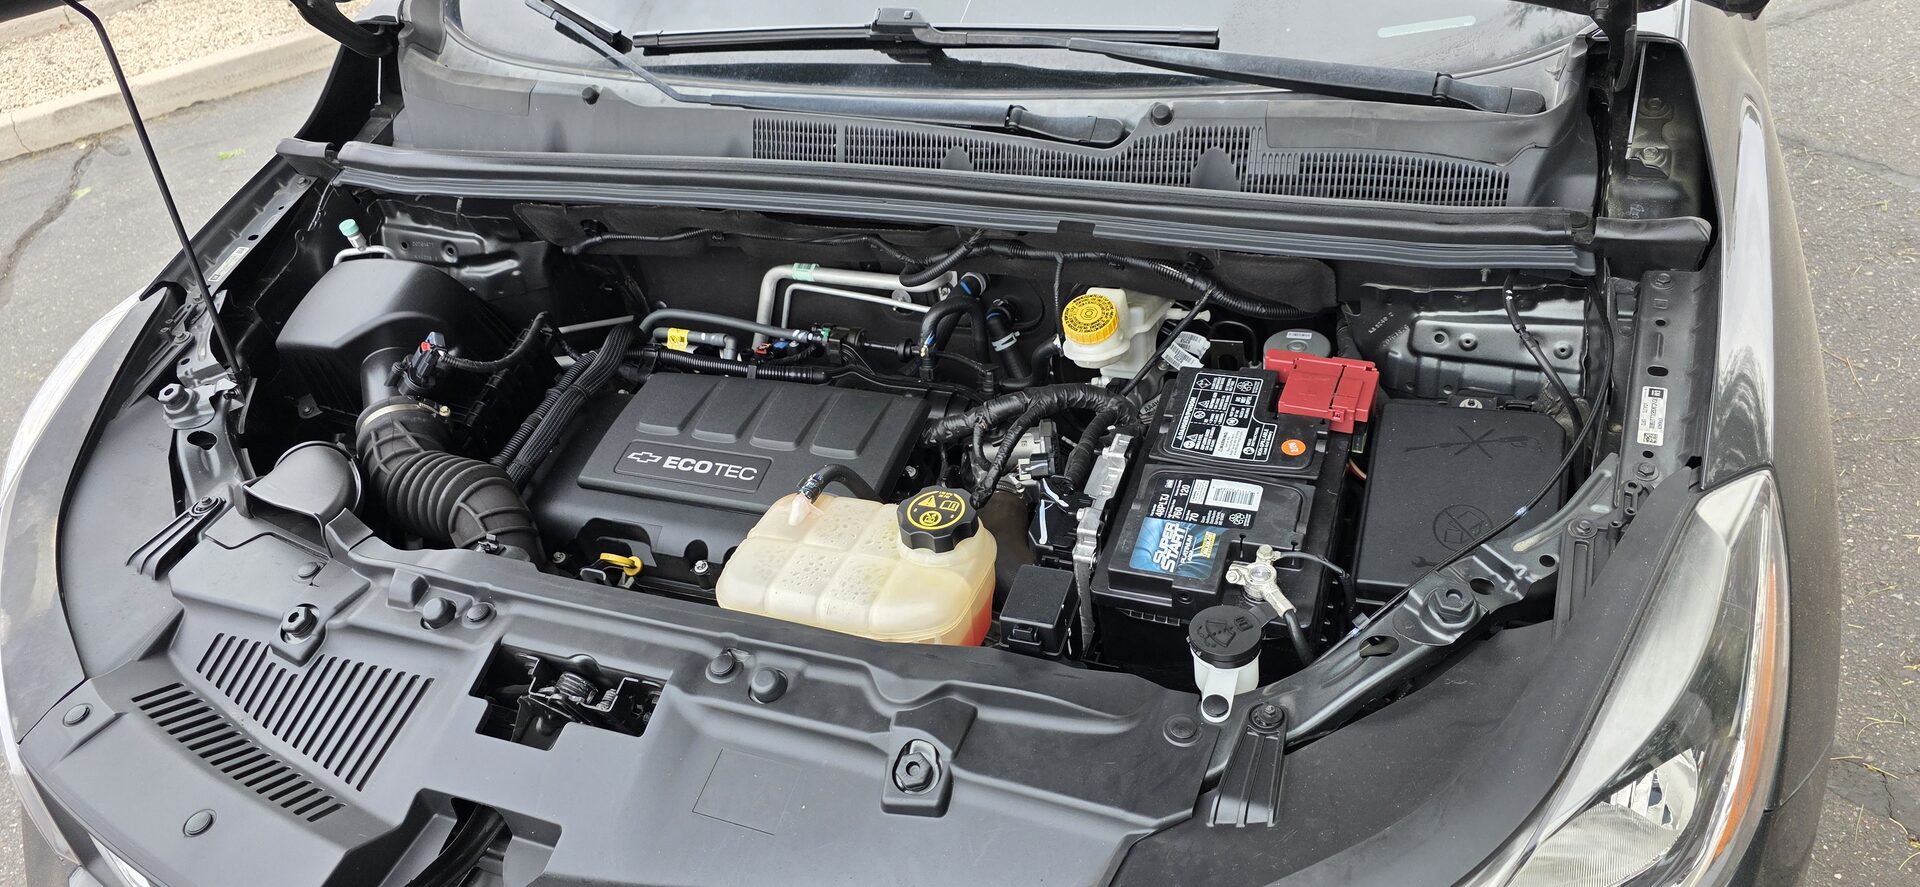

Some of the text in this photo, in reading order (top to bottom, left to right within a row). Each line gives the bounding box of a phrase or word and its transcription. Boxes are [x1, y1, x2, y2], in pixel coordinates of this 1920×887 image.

[663, 456, 757, 480] ECOTEC
[1155, 494, 1169, 517] 48PLTJ
[1172, 507, 1183, 519] 760
[1180, 484, 1190, 496] 120
[1189, 512, 1199, 521] 70
[1153, 521, 1177, 563] SUPER
[1160, 522, 1186, 572] START
[1180, 535, 1193, 564] PLATINUM
